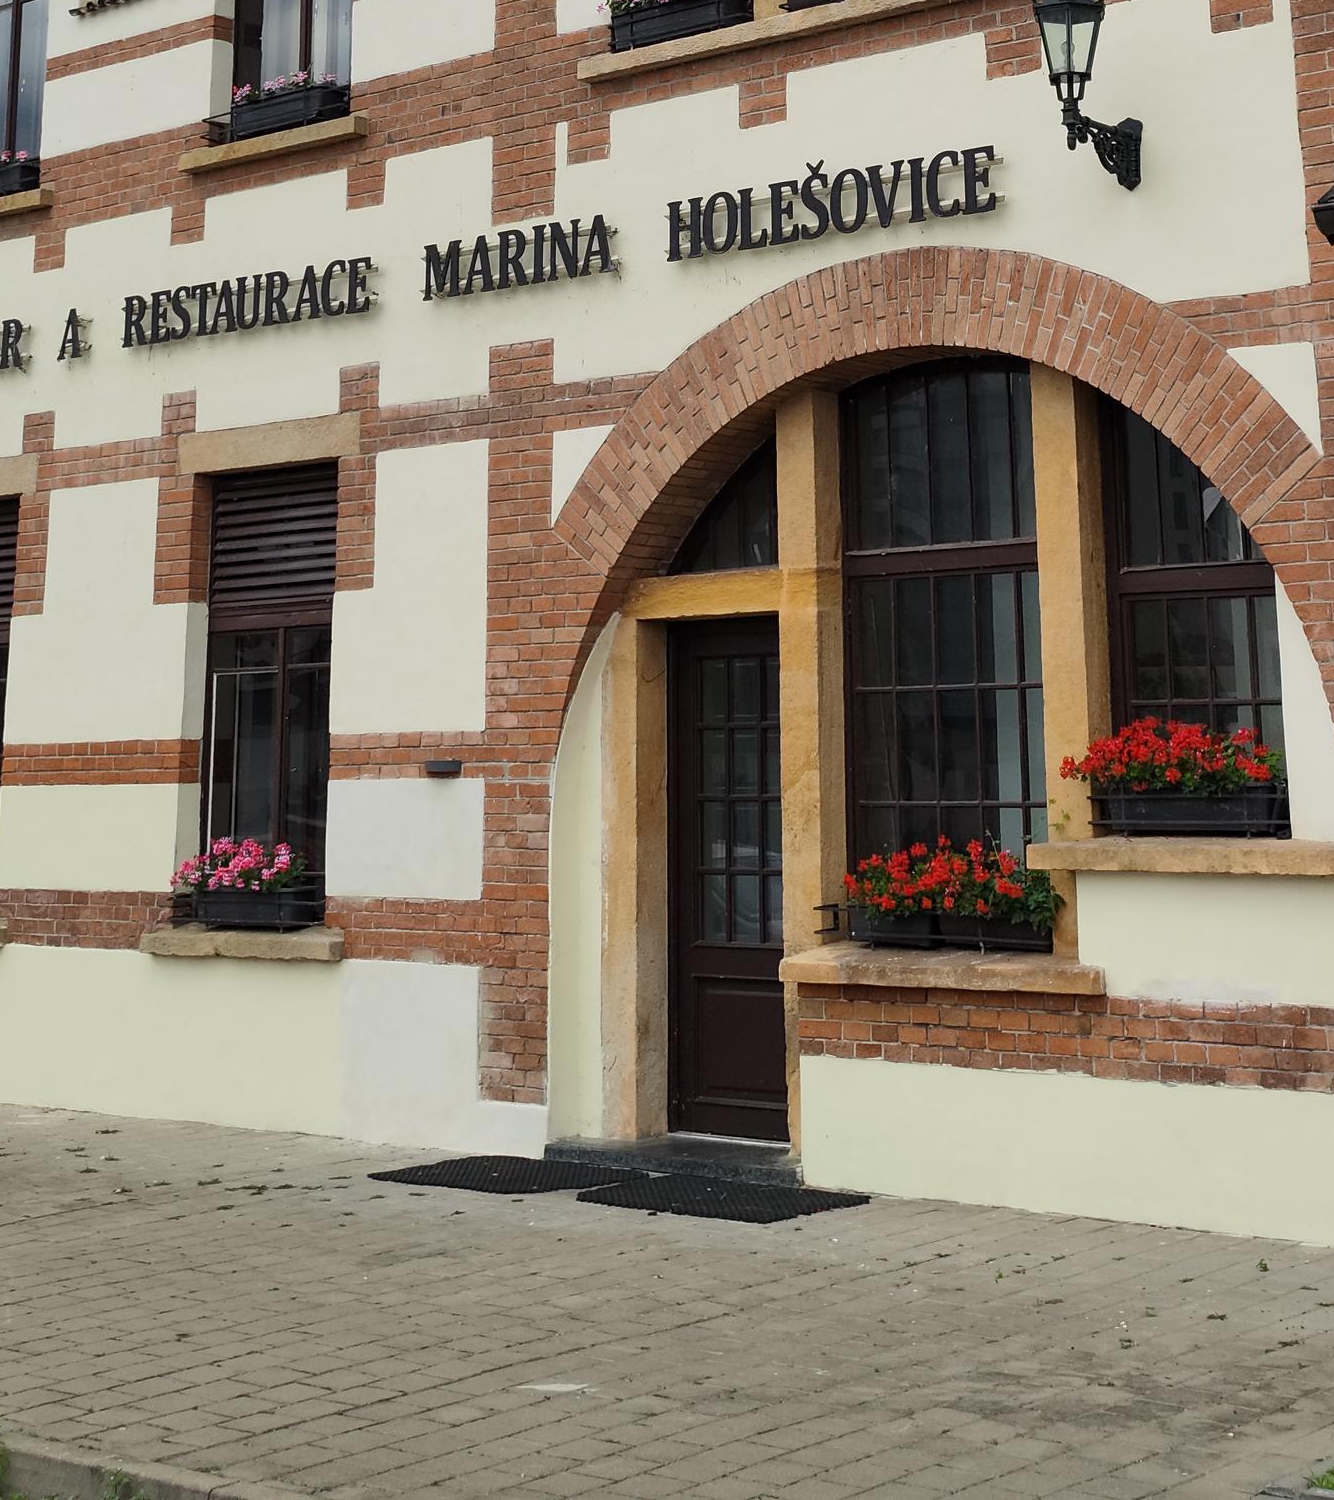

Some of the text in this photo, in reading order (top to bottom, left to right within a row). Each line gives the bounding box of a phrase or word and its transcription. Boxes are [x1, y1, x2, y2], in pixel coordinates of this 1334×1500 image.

[56, 308, 82, 361] A
[122, 256, 373, 348] RESTAURACE
[422, 214, 614, 302] MARINA
[666, 145, 998, 262] HOLEŠOVICE
